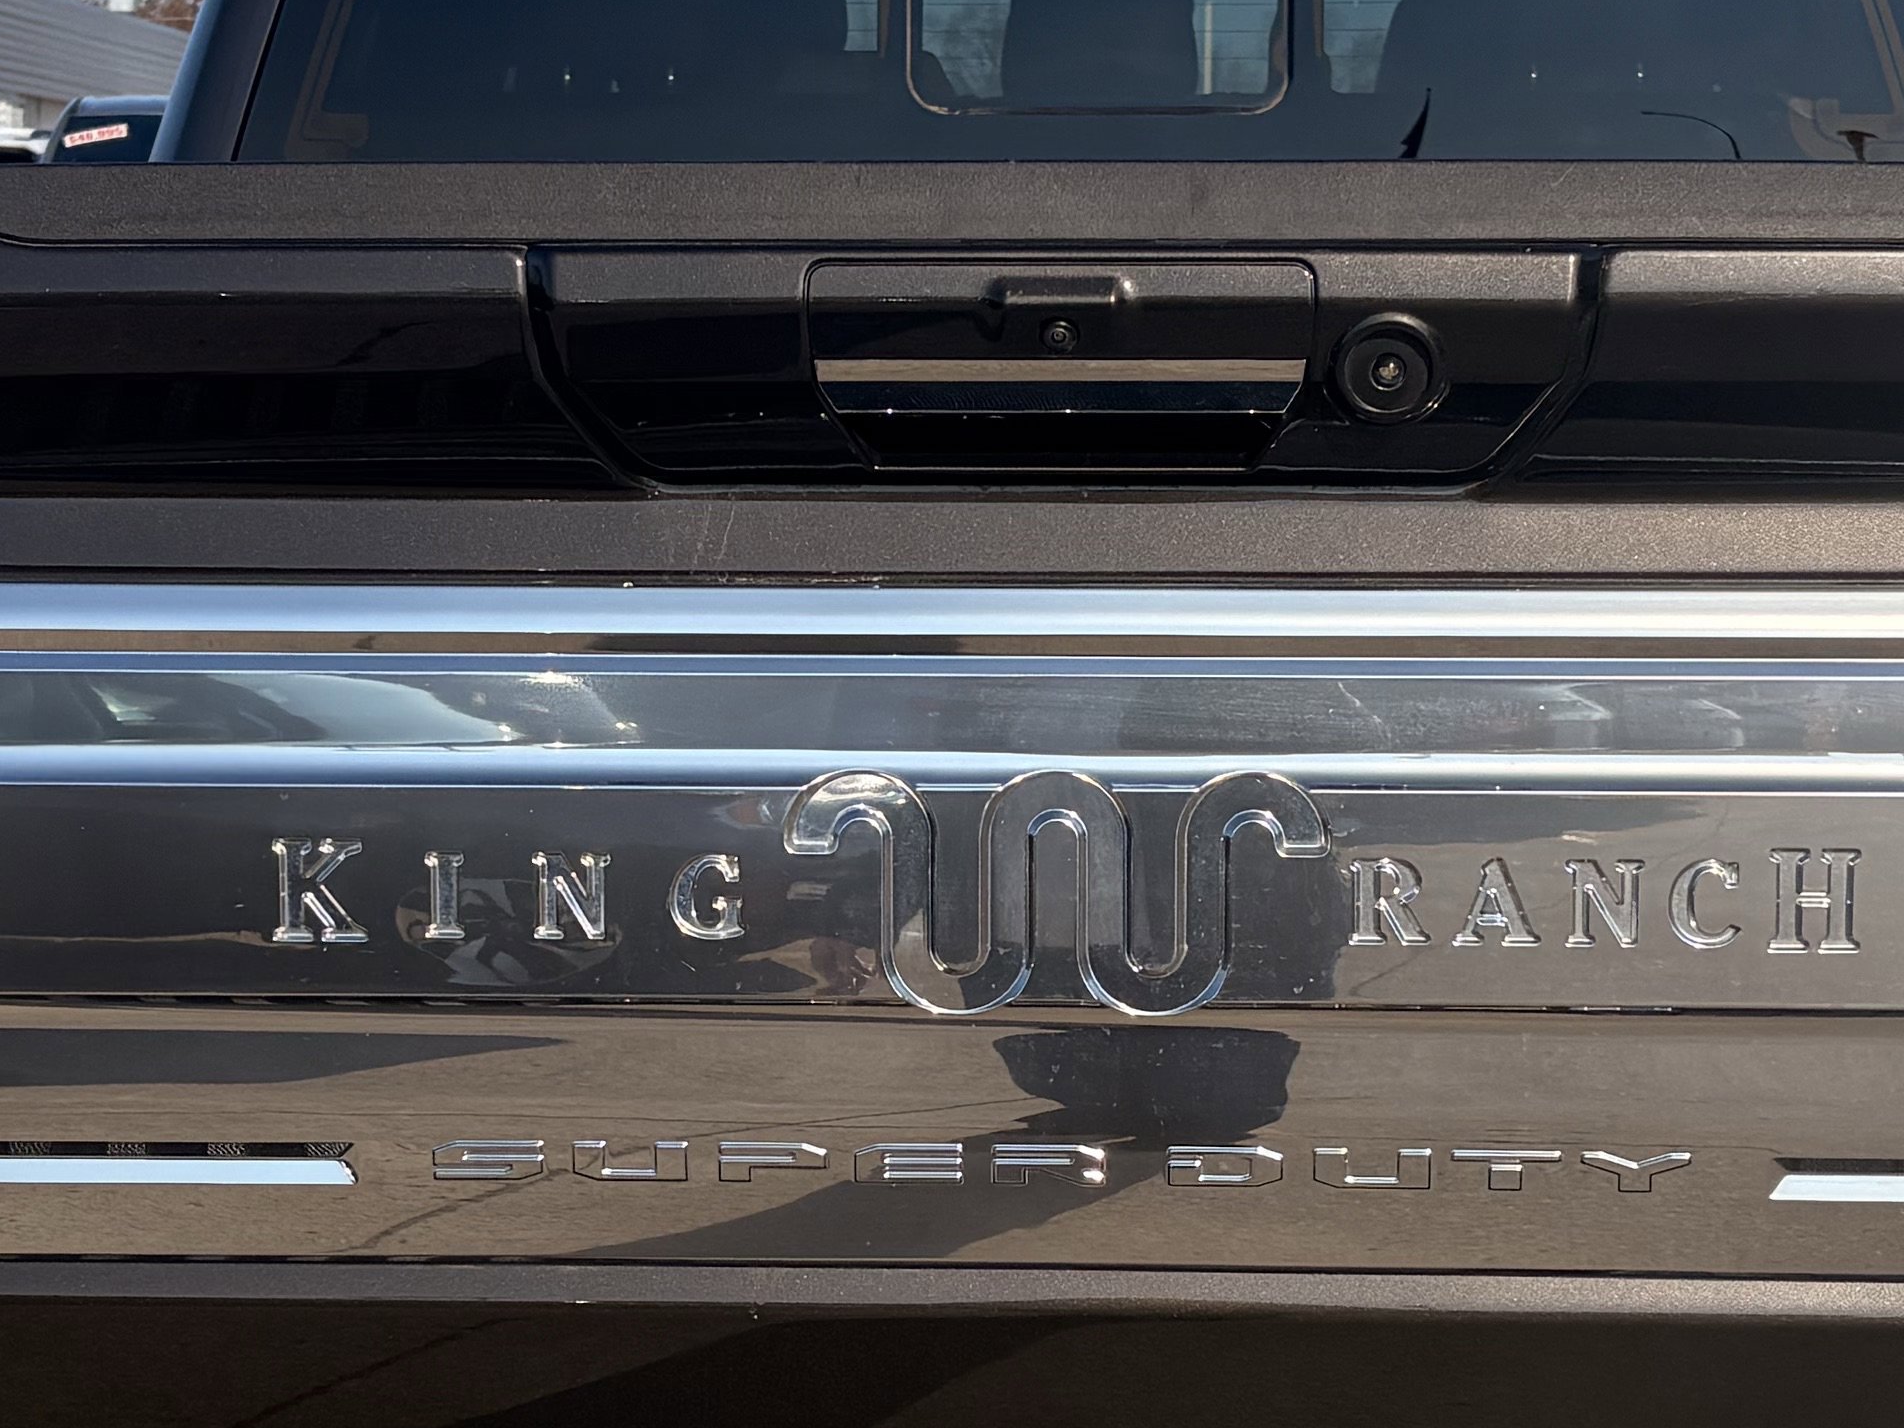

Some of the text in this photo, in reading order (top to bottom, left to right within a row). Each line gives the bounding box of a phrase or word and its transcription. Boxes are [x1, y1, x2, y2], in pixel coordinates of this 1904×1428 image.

[271, 837, 1863, 954] KING RANCH
[432, 1139, 1693, 1193] SUPER DUTY
